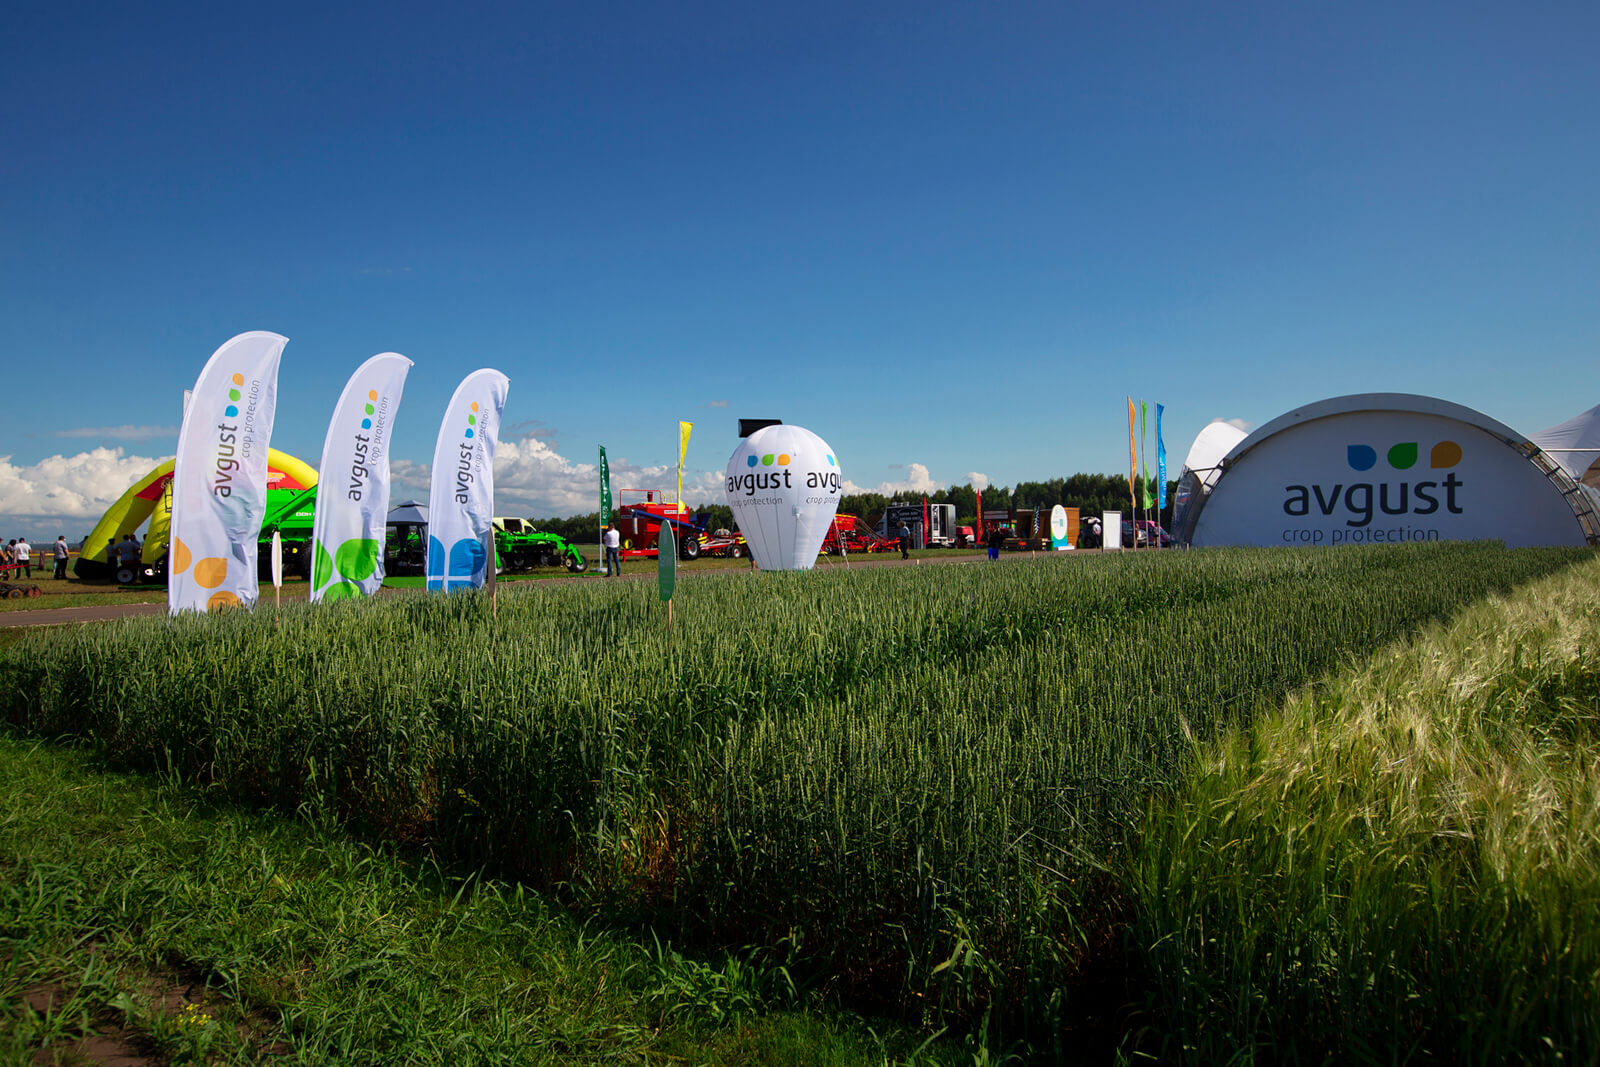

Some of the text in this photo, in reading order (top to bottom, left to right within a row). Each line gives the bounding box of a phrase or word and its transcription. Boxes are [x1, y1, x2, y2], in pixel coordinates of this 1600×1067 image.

[242, 380, 260, 458] crop protection
[374, 397, 388, 445] protection
[215, 423, 239, 498] avgust
[348, 434, 370, 501] avgust
[455, 442, 474, 504] avgust
[475, 454, 483, 473] crop
[728, 469, 792, 496] avgust
[743, 497, 782, 506] protection
[805, 496, 823, 504] crop
[1283, 472, 1463, 527] avgust
[1282, 525, 1439, 545] crop protection
